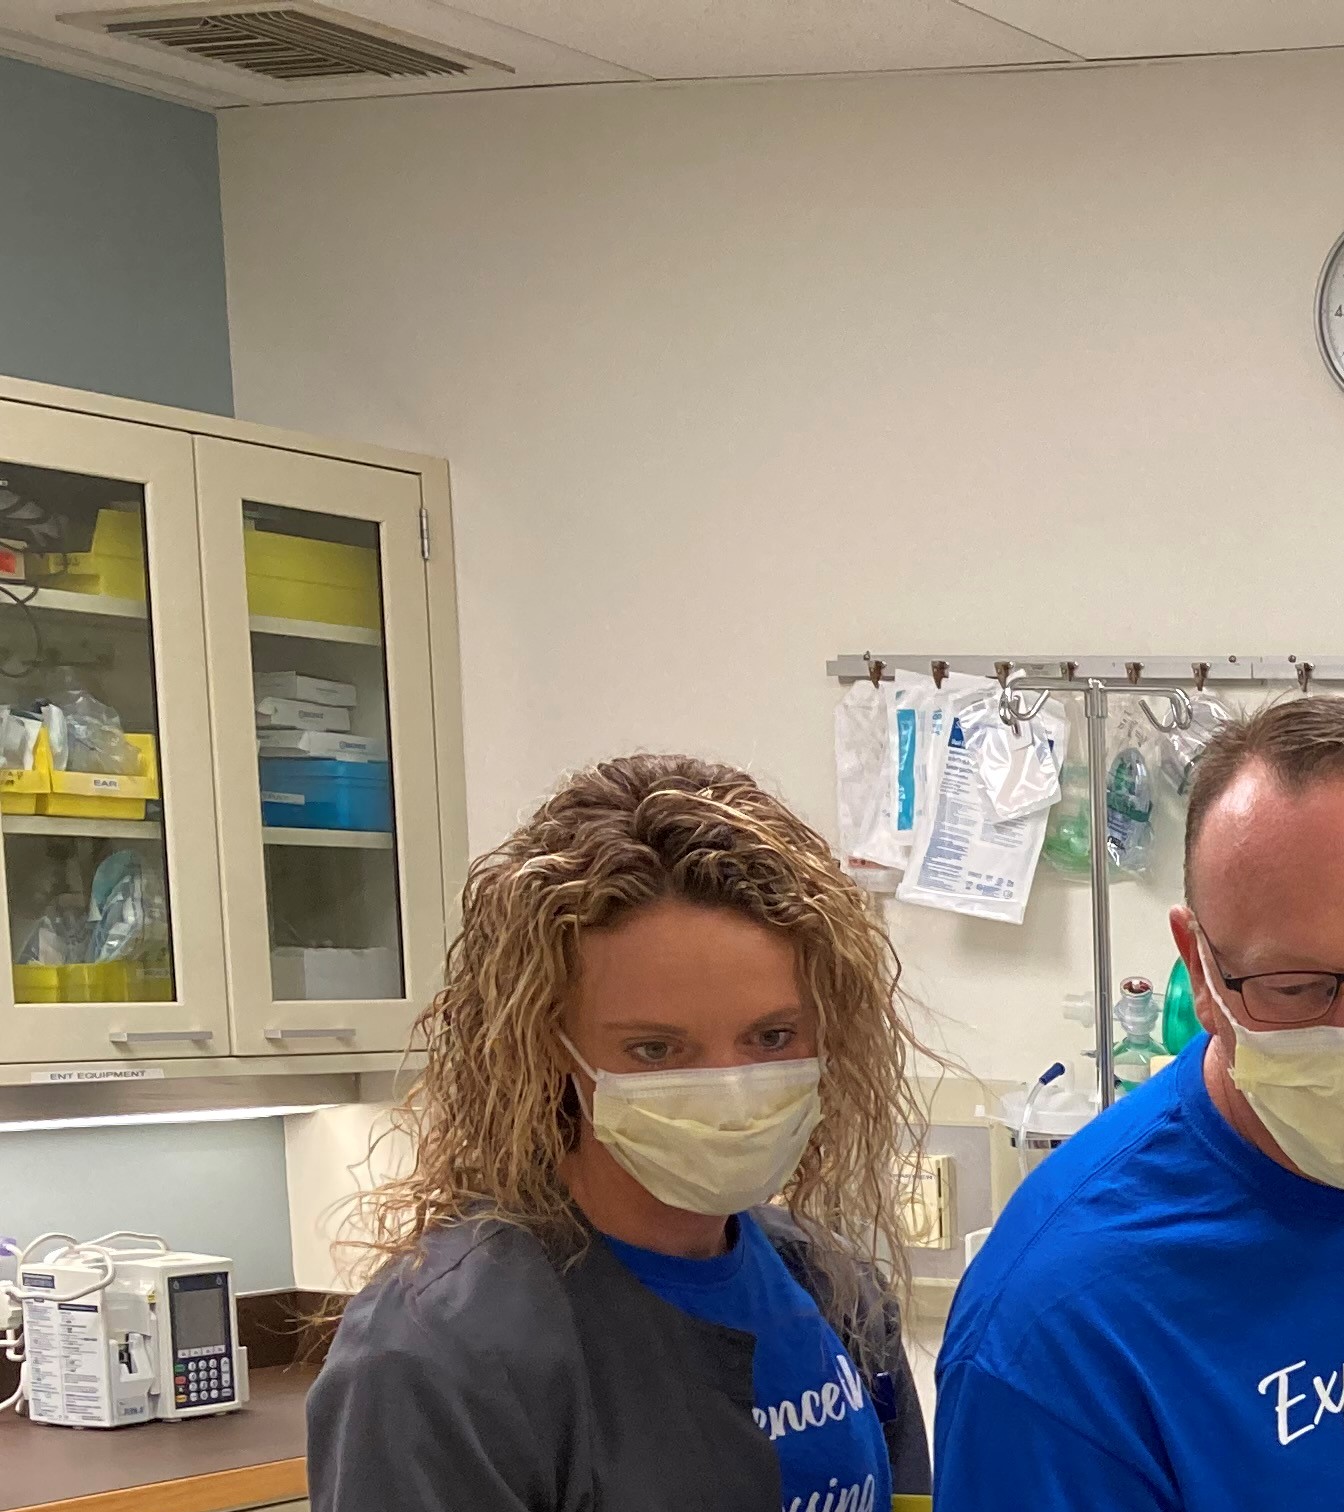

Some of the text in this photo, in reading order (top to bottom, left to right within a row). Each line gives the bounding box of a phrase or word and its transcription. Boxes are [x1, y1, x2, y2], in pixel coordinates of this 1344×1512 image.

[93, 779, 118, 788] EAR
[50, 1070, 146, 1081] ENT EQUIPMENT
